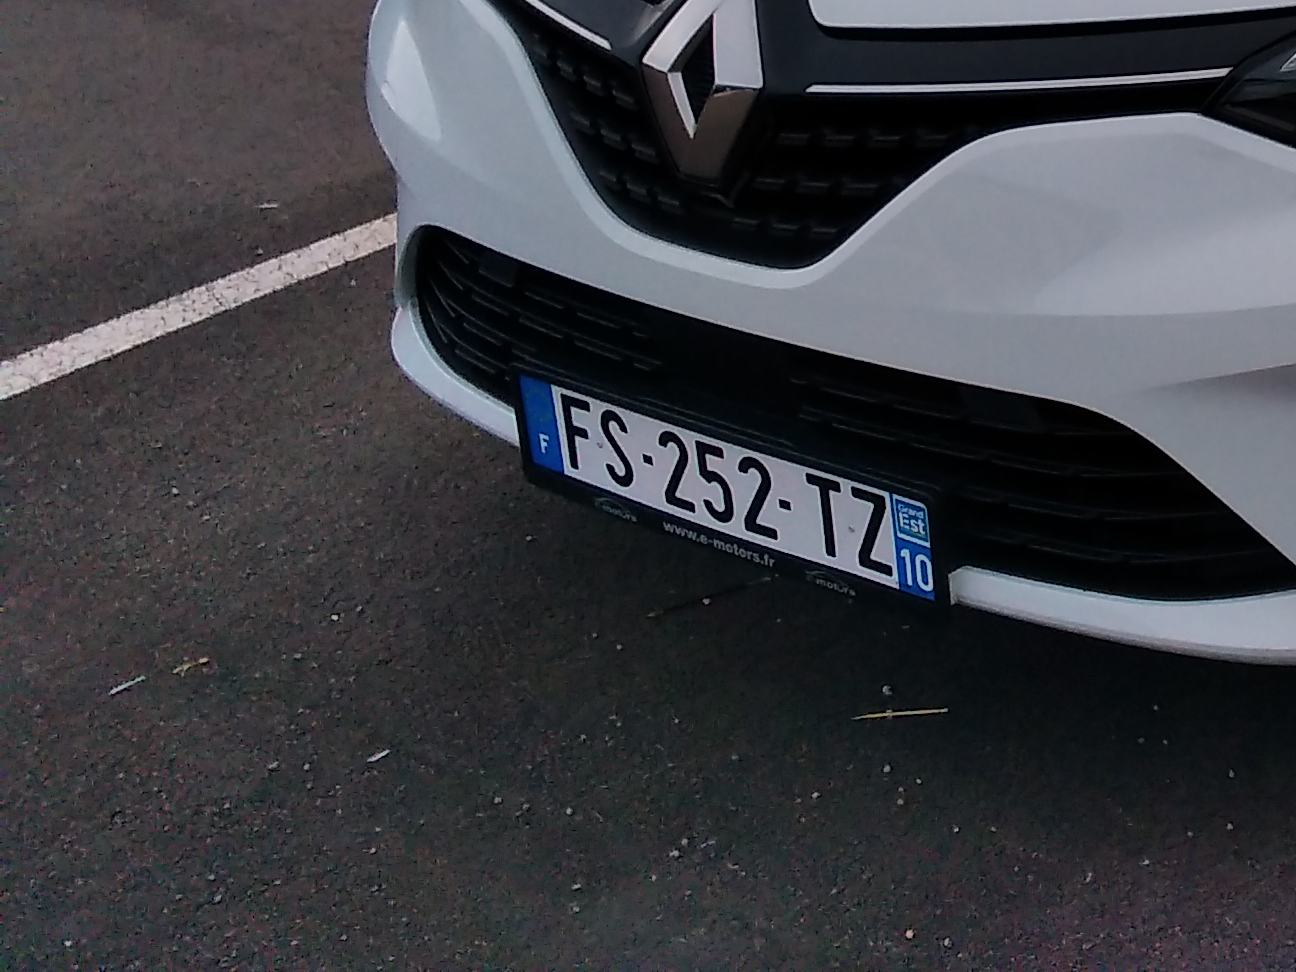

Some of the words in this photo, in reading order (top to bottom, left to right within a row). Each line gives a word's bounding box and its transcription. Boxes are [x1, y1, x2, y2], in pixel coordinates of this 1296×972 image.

[538, 432, 549, 454] F
[560, 392, 894, 578] FS-252-TZ
[662, 521, 776, 568] www.e-motors.fr
[899, 512, 926, 536] Est
[900, 548, 934, 592] 10
